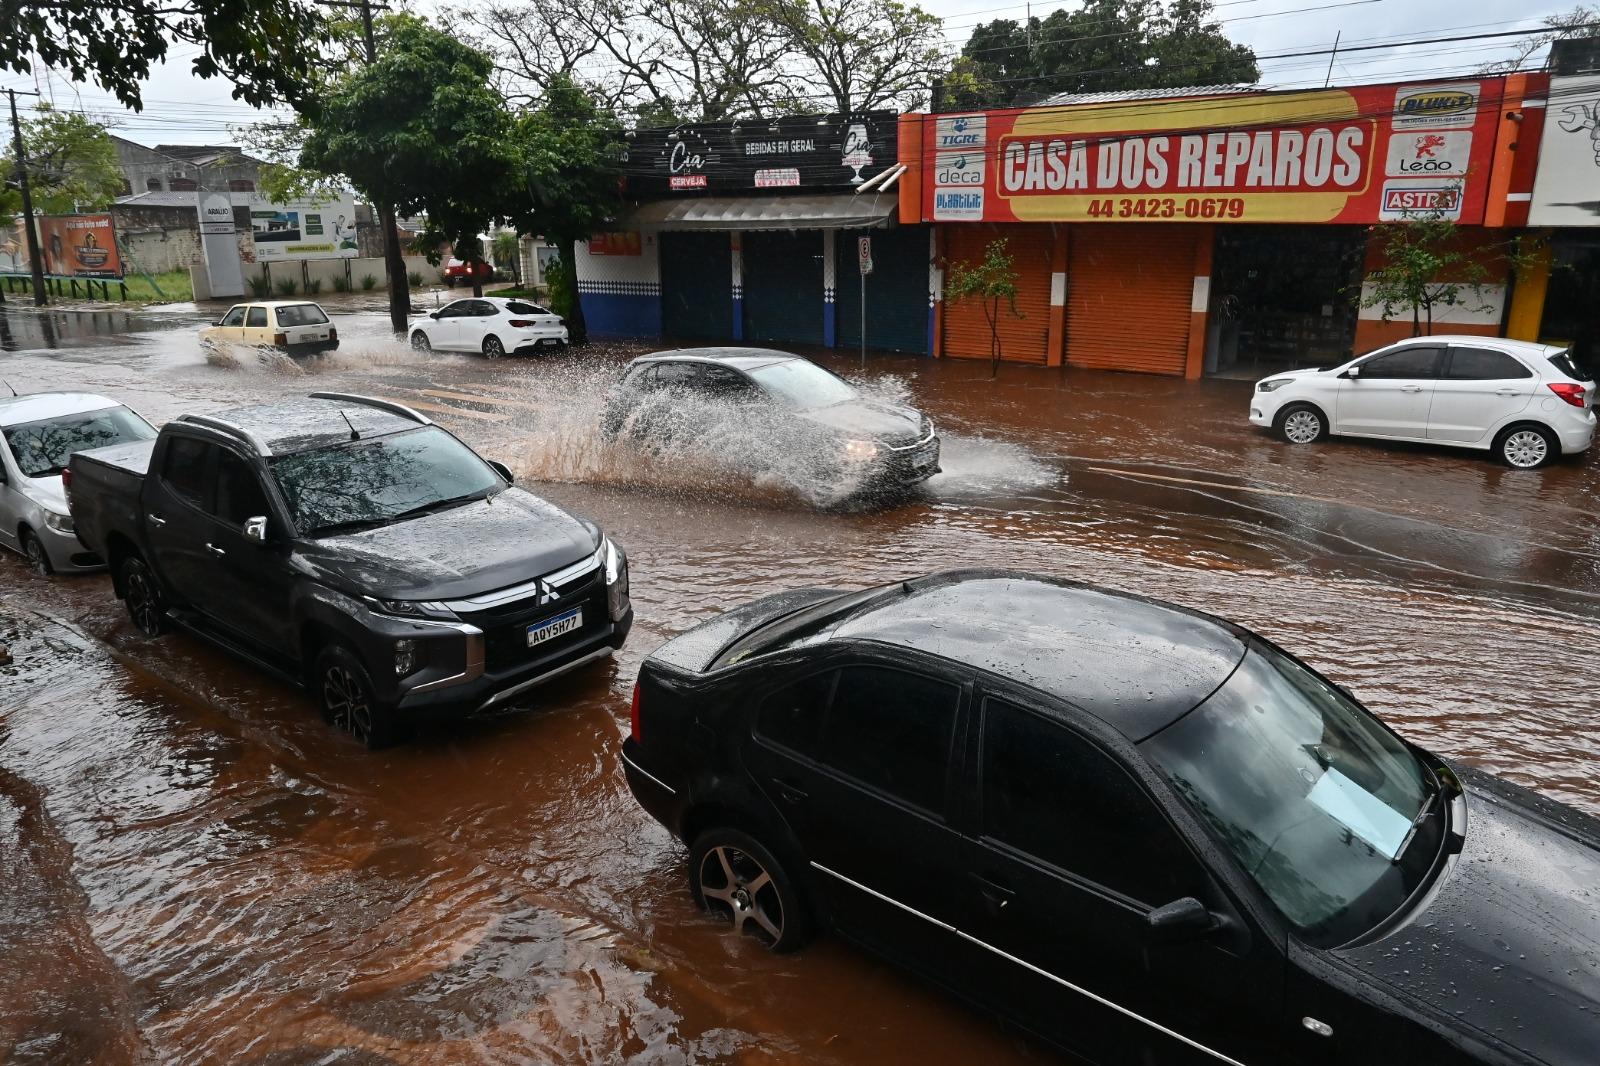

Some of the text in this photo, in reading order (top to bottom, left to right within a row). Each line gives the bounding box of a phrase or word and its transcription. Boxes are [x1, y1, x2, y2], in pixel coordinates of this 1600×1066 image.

[745, 139, 816, 155] BEBIDAS EM GERAL
[842, 131, 874, 156] Cia
[942, 134, 979, 145] TIGRE
[669, 141, 706, 173] Cia
[1004, 126, 1364, 192] CASA DOS REPAROS
[1400, 159, 1452, 171] Leão
[671, 176, 705, 187] CERVEJA
[939, 169, 981, 184] deca
[1087, 198, 1244, 219] 44 3423-0679
[533, 615, 577, 643] AQY5H77
